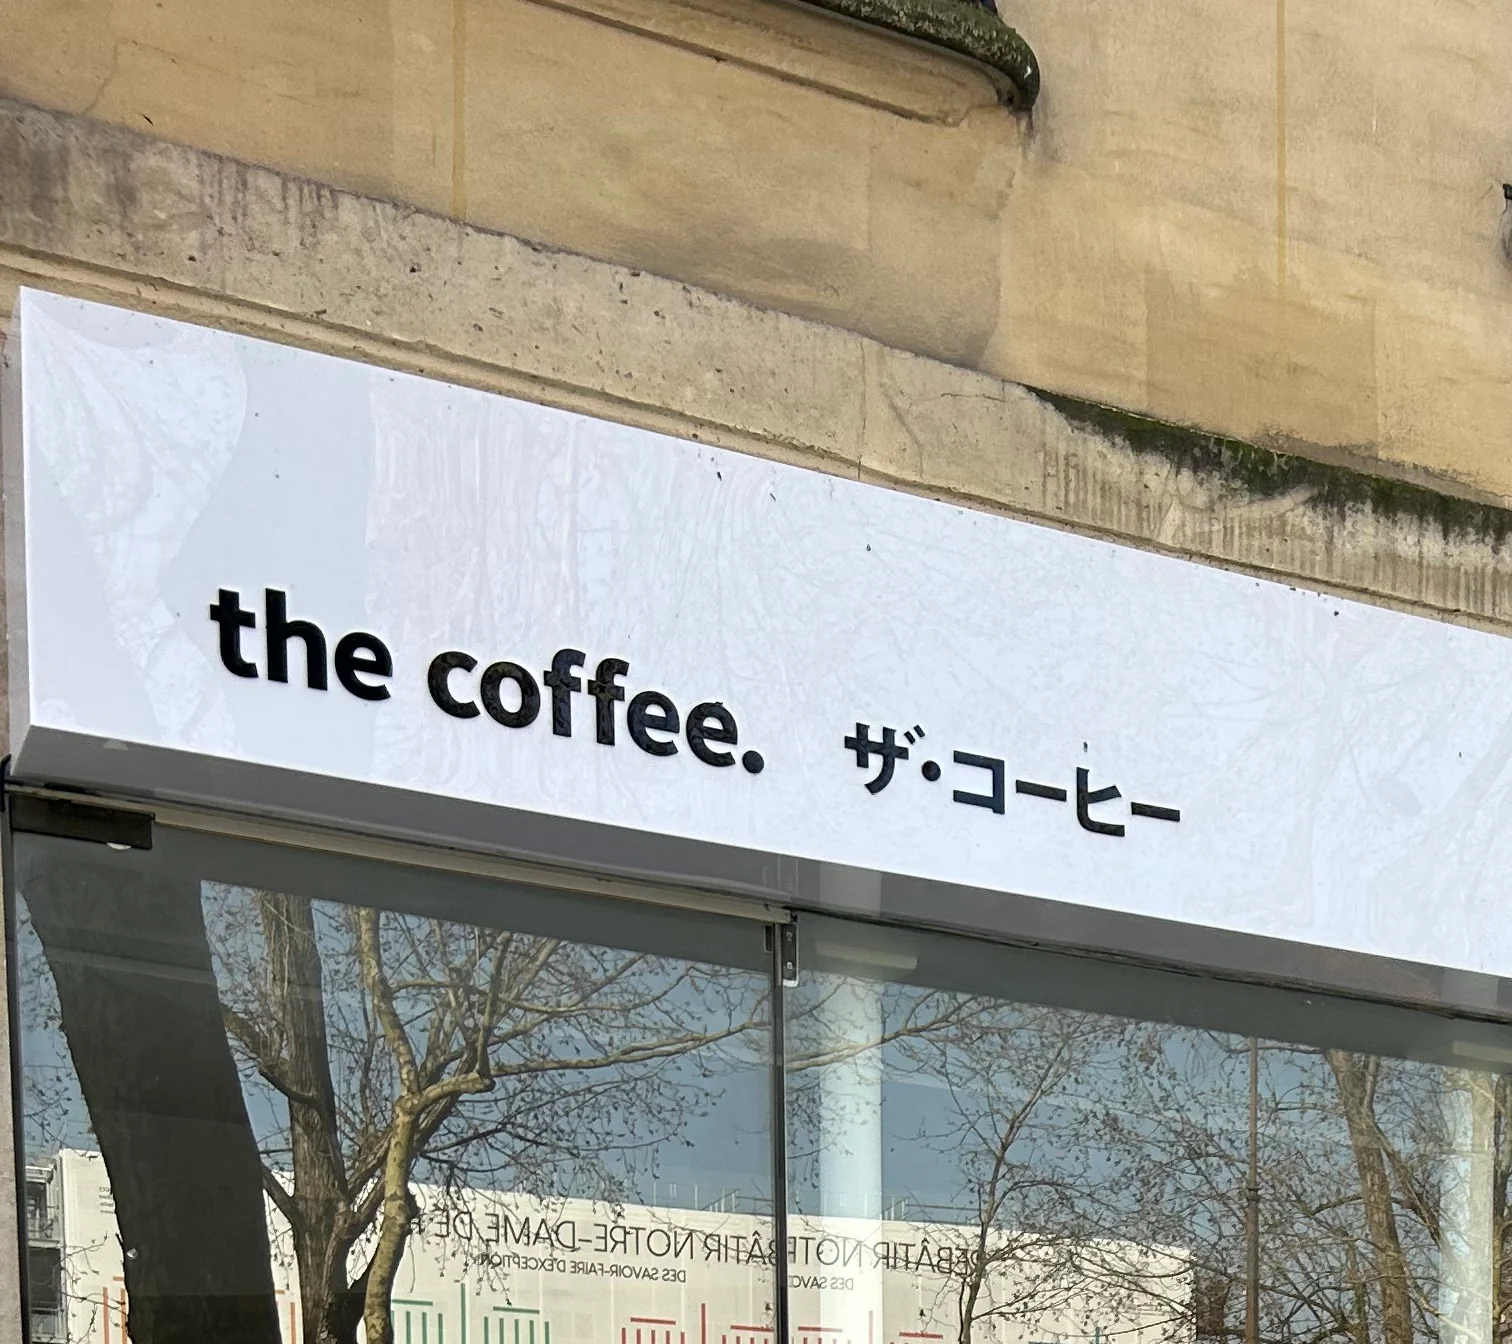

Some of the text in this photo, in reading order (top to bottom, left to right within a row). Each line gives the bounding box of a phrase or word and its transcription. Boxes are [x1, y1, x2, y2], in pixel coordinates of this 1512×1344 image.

[209, 587, 765, 776] the coffee.
[843, 722, 1182, 838] ザ・コーヒー
